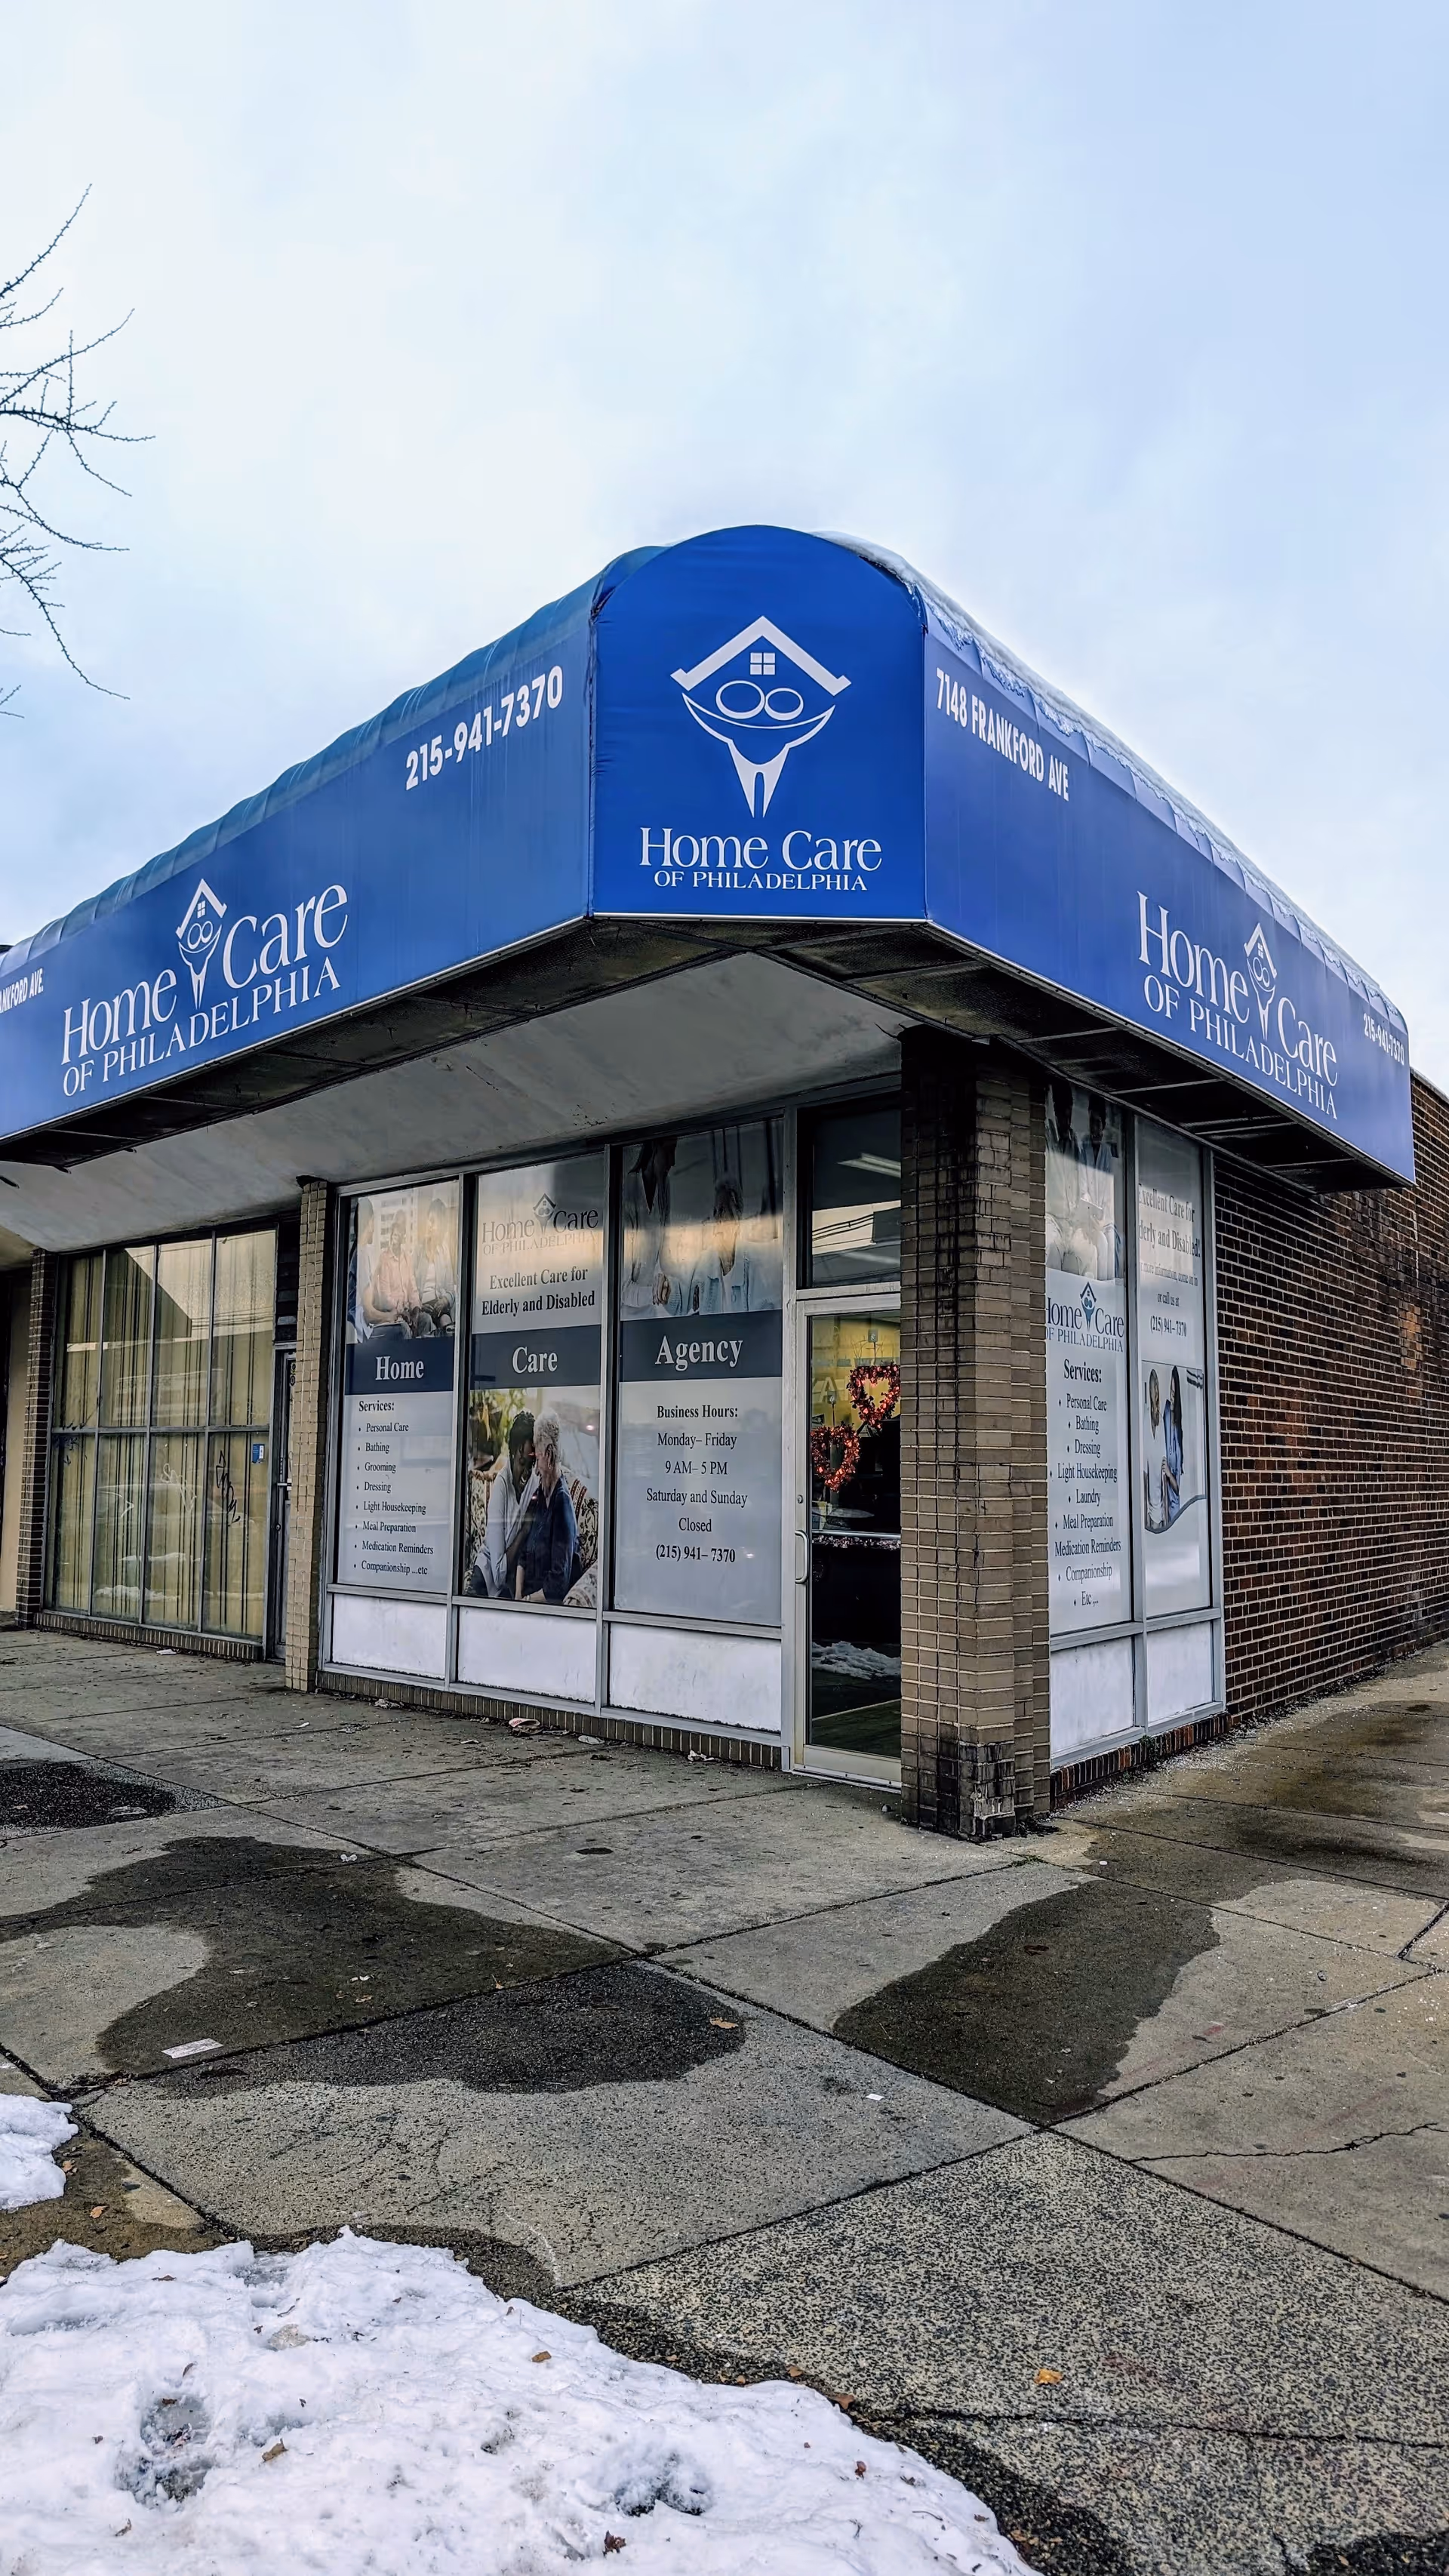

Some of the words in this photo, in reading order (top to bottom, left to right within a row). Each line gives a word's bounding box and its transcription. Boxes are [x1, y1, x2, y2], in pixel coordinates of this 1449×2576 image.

[405, 666, 563, 790] 215-941-7370
[937, 667, 968, 727] 7148
[972, 694, 1044, 782] FRANKFORD
[1048, 755, 1069, 802] AVE
[639, 827, 768, 869] Home
[782, 830, 882, 872] Care
[654, 870, 685, 888] OF
[693, 872, 867, 891] PHILADELPHIA
[29, 968, 44, 999] AVE.
[61, 968, 178, 1065] Home
[223, 884, 349, 989] Care
[1137, 891, 1250, 1023] Home
[1278, 997, 1338, 1087] Care
[63, 1059, 94, 1097] OF
[102, 956, 341, 1084] PHILADELPHIA
[1144, 975, 1180, 1019] OF
[1189, 998, 1337, 1120] PHILADELPHIA
[1363, 1012, 1404, 1066] 215-941-7370
[1169, 1195, 1185, 1219] Care
[1186, 1201, 1195, 1223] for
[482, 1219, 535, 1245] Home
[553, 1209, 599, 1233] Care
[483, 1244, 498, 1256] OF
[1158, 1228, 1170, 1248] and
[1171, 1230, 1201, 1257] Disabled!
[490, 1271, 538, 1290] Excellent
[540, 1269, 568, 1285] Care
[571, 1266, 589, 1282] for
[481, 1298, 520, 1317] Elderly
[522, 1295, 543, 1313] and
[546, 1290, 595, 1310] Disabled
[1171, 1296, 1175, 1306] us
[1095, 1307, 1124, 1338] Care
[1150, 1315, 1163, 1335] (215)
[1176, 1320, 1187, 1337] 7370
[1057, 1328, 1123, 1353] PHILADELPHIA
[512, 1346, 558, 1374] Care
[654, 1335, 743, 1371] Agency
[375, 1356, 424, 1381] Home
[1064, 1359, 1102, 1383] Services:
[358, 1400, 395, 1412] Services:
[657, 1405, 699, 1418] Business
[702, 1405, 738, 1418] Hours:
[1066, 1393, 1092, 1410] Personal
[1094, 1396, 1107, 1411] Care
[366, 1423, 392, 1433] Personal
[394, 1422, 409, 1432] Care
[1075, 1415, 1099, 1435] Bathing
[365, 1442, 389, 1454] Bathing
[705, 1433, 737, 1449] Friday
[1075, 1439, 1100, 1458] Dressing
[365, 1461, 396, 1474] Grooming
[665, 1460, 672, 1473] 9
[700, 1461, 707, 1475] 5
[709, 1462, 728, 1475] PM
[1057, 1463, 1075, 1483] Light
[1076, 1463, 1117, 1483] Housekeeping
[364, 1481, 392, 1494] Dressing
[1076, 1488, 1100, 1507] Laundry
[364, 1500, 380, 1513] Light
[382, 1501, 426, 1515] Housekeeping
[647, 1488, 688, 1506] Saturday
[690, 1490, 708, 1503] and
[710, 1491, 748, 1508] Sunday
[362, 1521, 378, 1531] Meal
[380, 1522, 417, 1534] Preparation
[678, 1517, 712, 1532] Closed
[1063, 1513, 1078, 1529] Meal
[1081, 1513, 1113, 1531] Preparation
[362, 1540, 397, 1552] Medication
[398, 1543, 434, 1554] Reminders
[656, 1544, 681, 1562] (215)
[711, 1548, 735, 1563] 7370
[1055, 1539, 1089, 1556] Medication
[1091, 1537, 1121, 1553] Reminders
[361, 1560, 411, 1575] Companionship
[1066, 1561, 1112, 1583] Companionship
